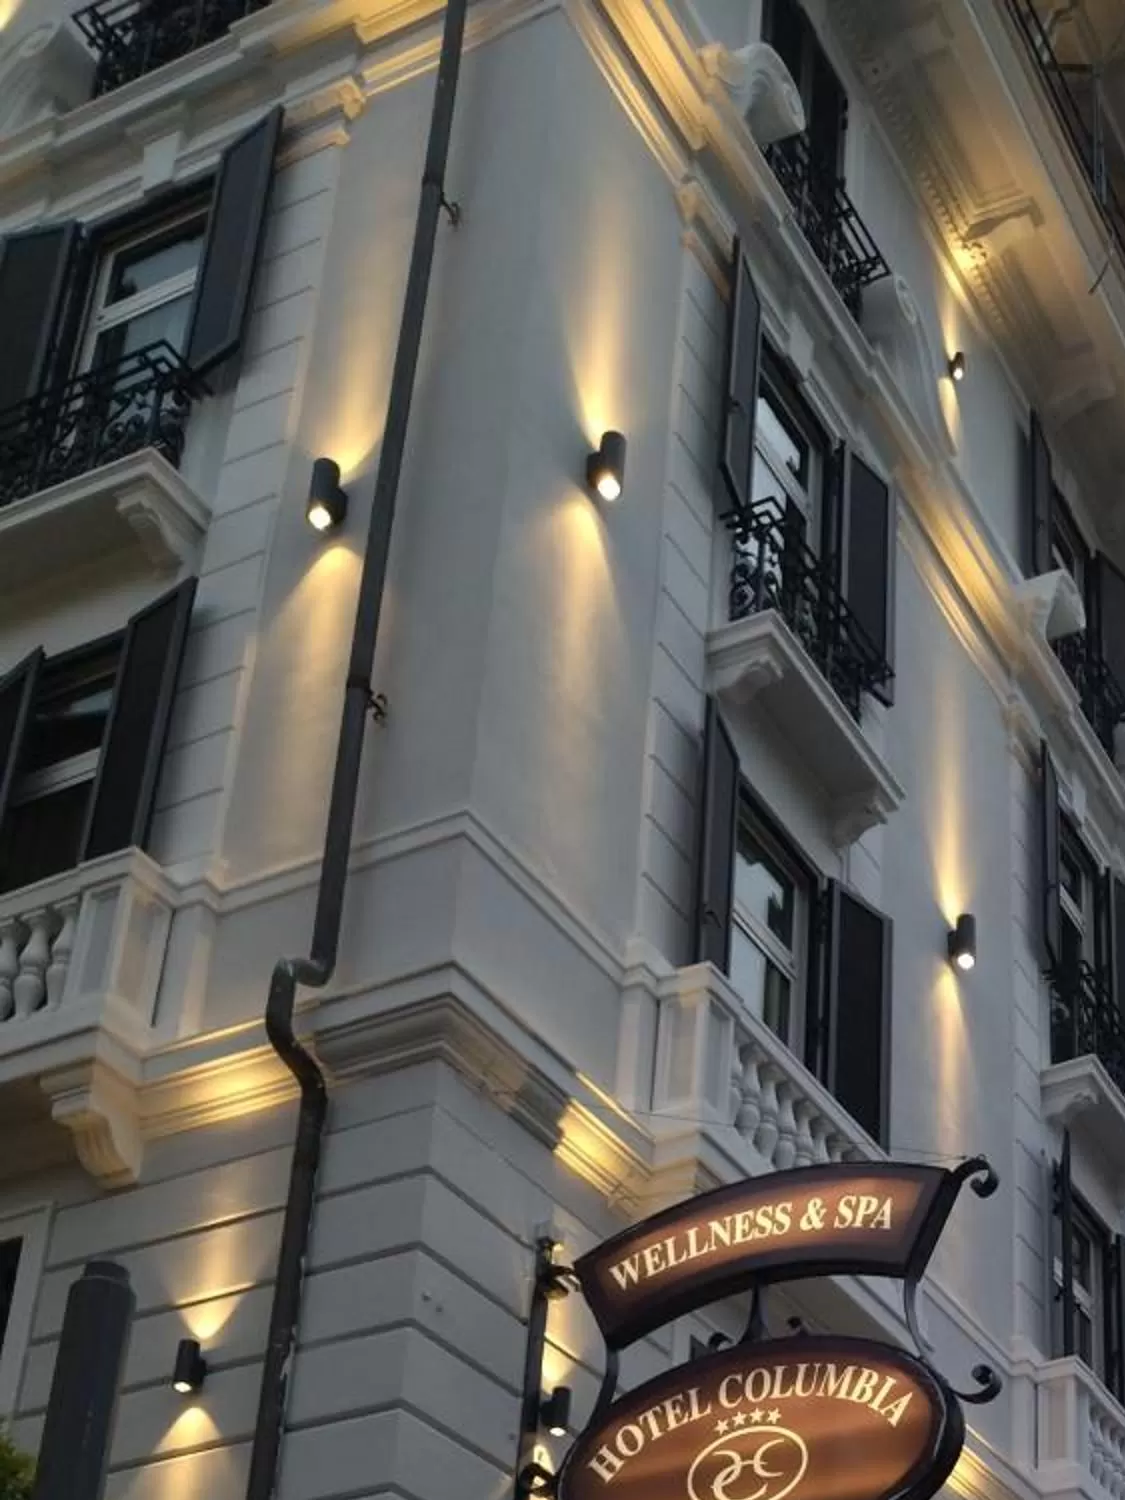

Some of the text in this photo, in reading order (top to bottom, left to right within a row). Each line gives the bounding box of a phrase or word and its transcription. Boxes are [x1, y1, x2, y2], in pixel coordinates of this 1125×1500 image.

[609, 1196, 894, 1291] WELLNESS & SPA
[587, 1362, 914, 1484] HOTEL COLUMBIA
